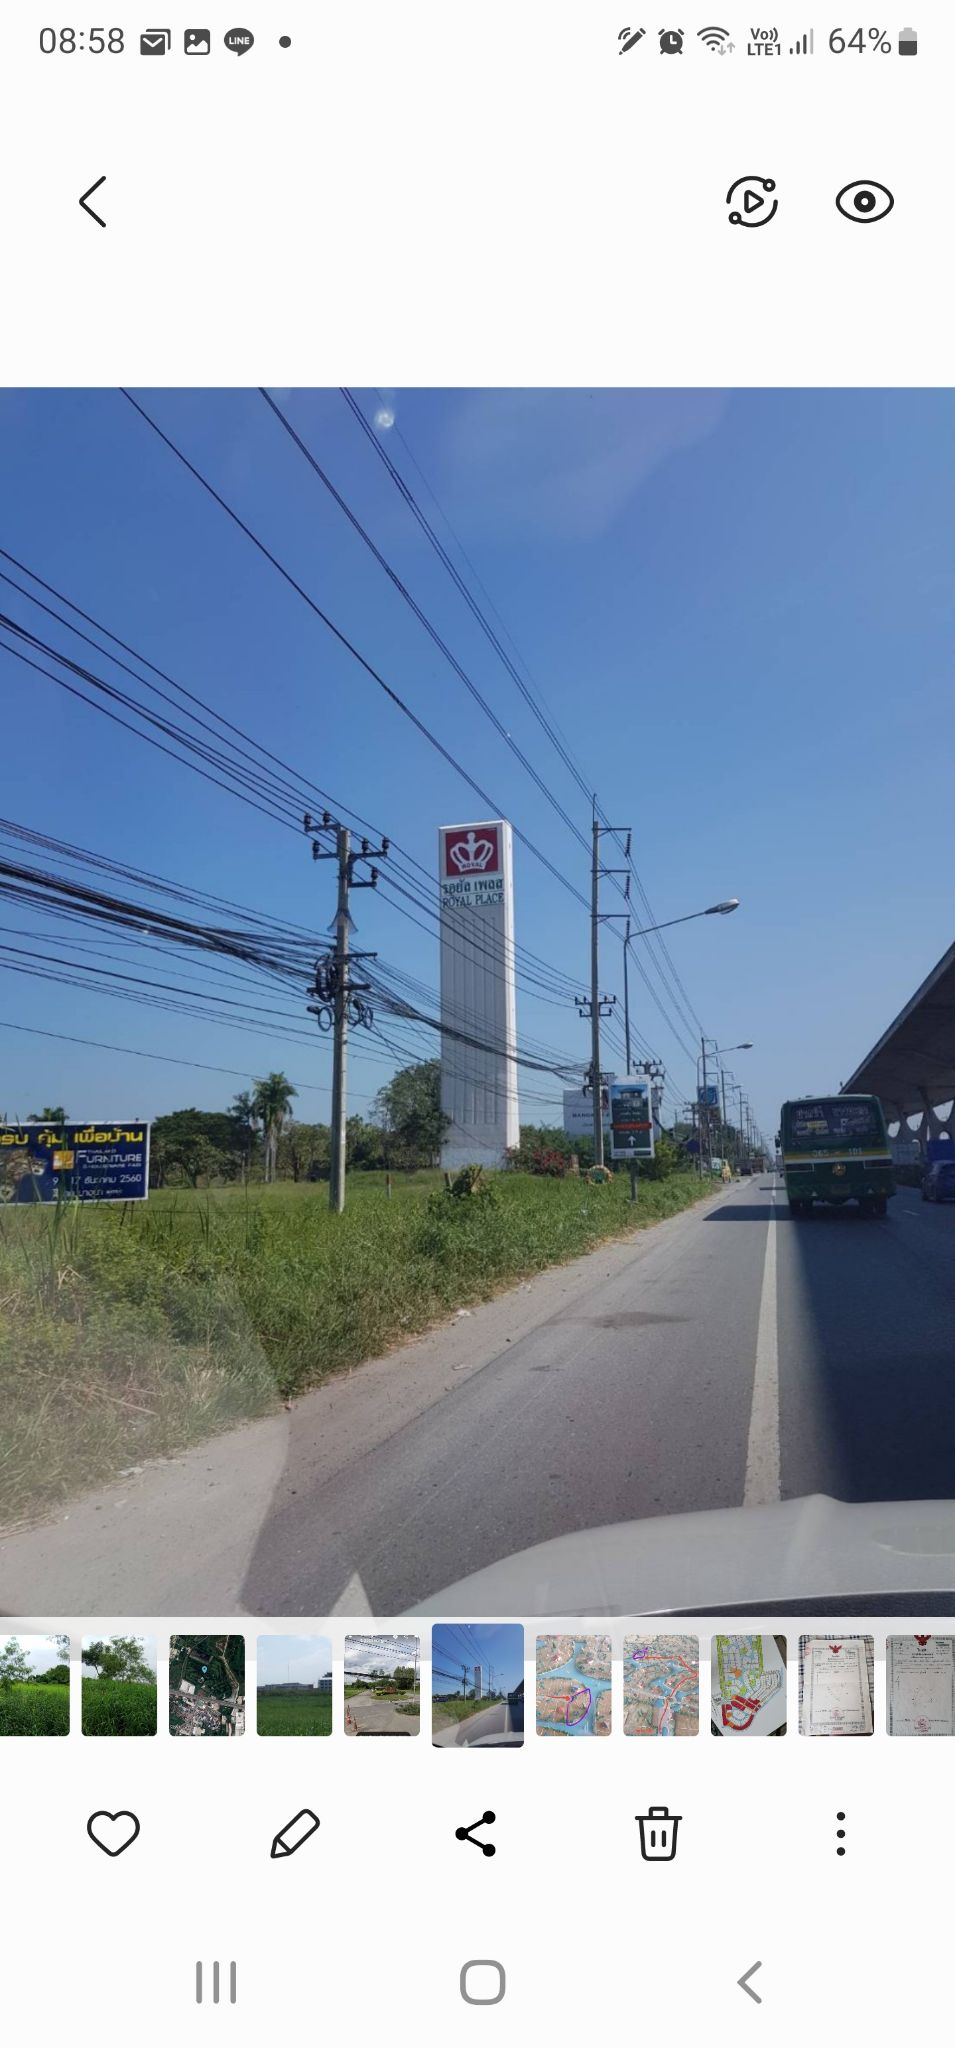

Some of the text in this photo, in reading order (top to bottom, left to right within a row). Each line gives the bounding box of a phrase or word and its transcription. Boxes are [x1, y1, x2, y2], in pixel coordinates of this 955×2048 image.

[442, 892, 504, 908] ROYAL PLACE
[74, 1126, 143, 1144] เพื่อบ้าน
[76, 1150, 142, 1164] FURNITURE
[120, 1173, 142, 1183] 2560
